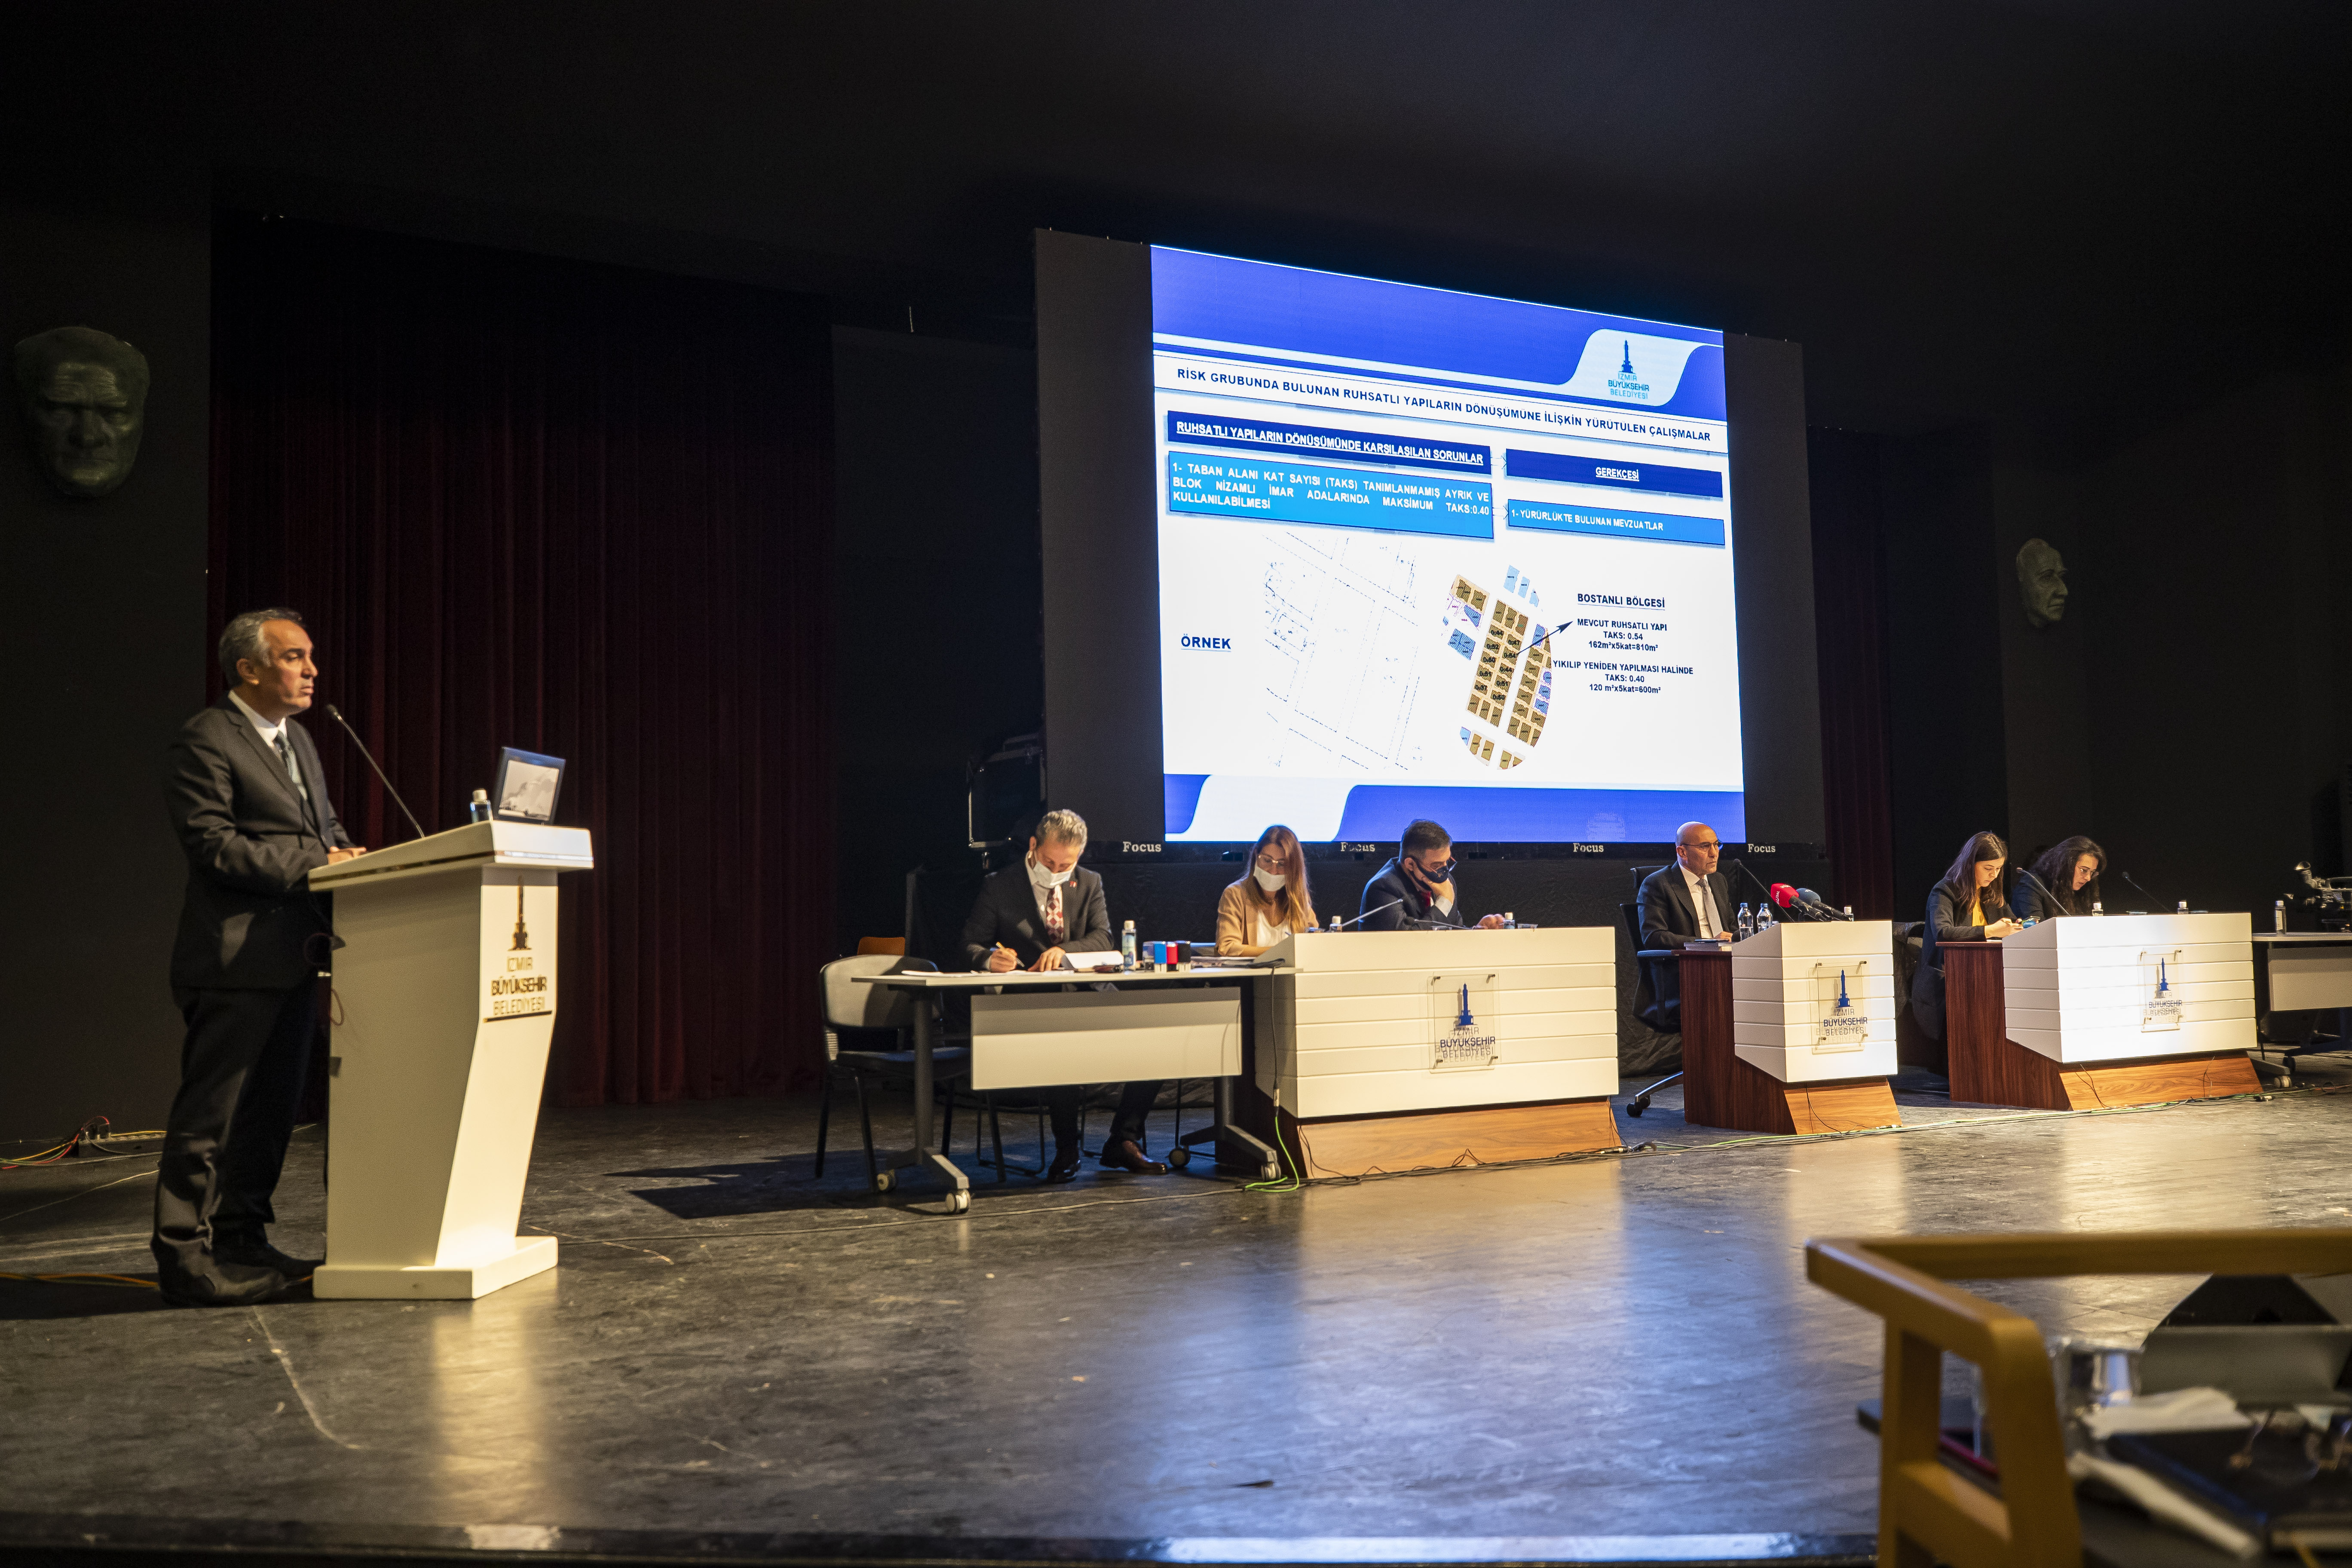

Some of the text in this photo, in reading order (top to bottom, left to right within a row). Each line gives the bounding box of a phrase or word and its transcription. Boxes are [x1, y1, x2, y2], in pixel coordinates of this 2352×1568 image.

[1178, 368, 1711, 441] RİSK GRUBUNDA BULUNAN RUHSATLI YAPILARIN DÖNÜŞÜMÜNE İLİŞKİN YÜRÜTÜLEN ÇALIŞMALAR
[1176, 421, 1228, 436] RUHSATLI
[1230, 427, 1283, 442] YAPILARIN
[1286, 432, 1361, 451] DÖNÜŞÜMÜNDE
[1433, 450, 1483, 463] SORUNLAR
[1596, 467, 1639, 480] GEREKÇESİ
[1173, 462, 1489, 502] 1- TABAN ALANI KAT SAYISI (TAKS) TANIMLANMAMIŞ AYRIK VE
[1173, 477, 1489, 515] BLOK NİZAMLI İMAR ADALARINDA MAKSİMUM TAKS:0.40
[1173, 491, 1271, 509] KULLANILABİLMESİ
[1511, 509, 1519, 518] 1-
[1575, 514, 1611, 526] BULUNAN
[1613, 518, 1663, 531] MEVZUATLAR
[1577, 593, 1665, 607] BOSTANLI BÖLGESİ
[1577, 618, 1608, 628] MEVCUT
[1611, 621, 1648, 630] RUHSATLI
[1181, 633, 1231, 649] ÖRNEK
[1603, 631, 1625, 640] TAKS:
[1553, 660, 1693, 674] YIKILIP YENİDEN YAPILMASI HALİNDE
[1605, 674, 1627, 682] TAKS:
[1123, 841, 1161, 852] Focus
[1341, 842, 1375, 852] Fcus
[1573, 842, 1604, 852] Focus
[1748, 844, 1776, 853] Focus
